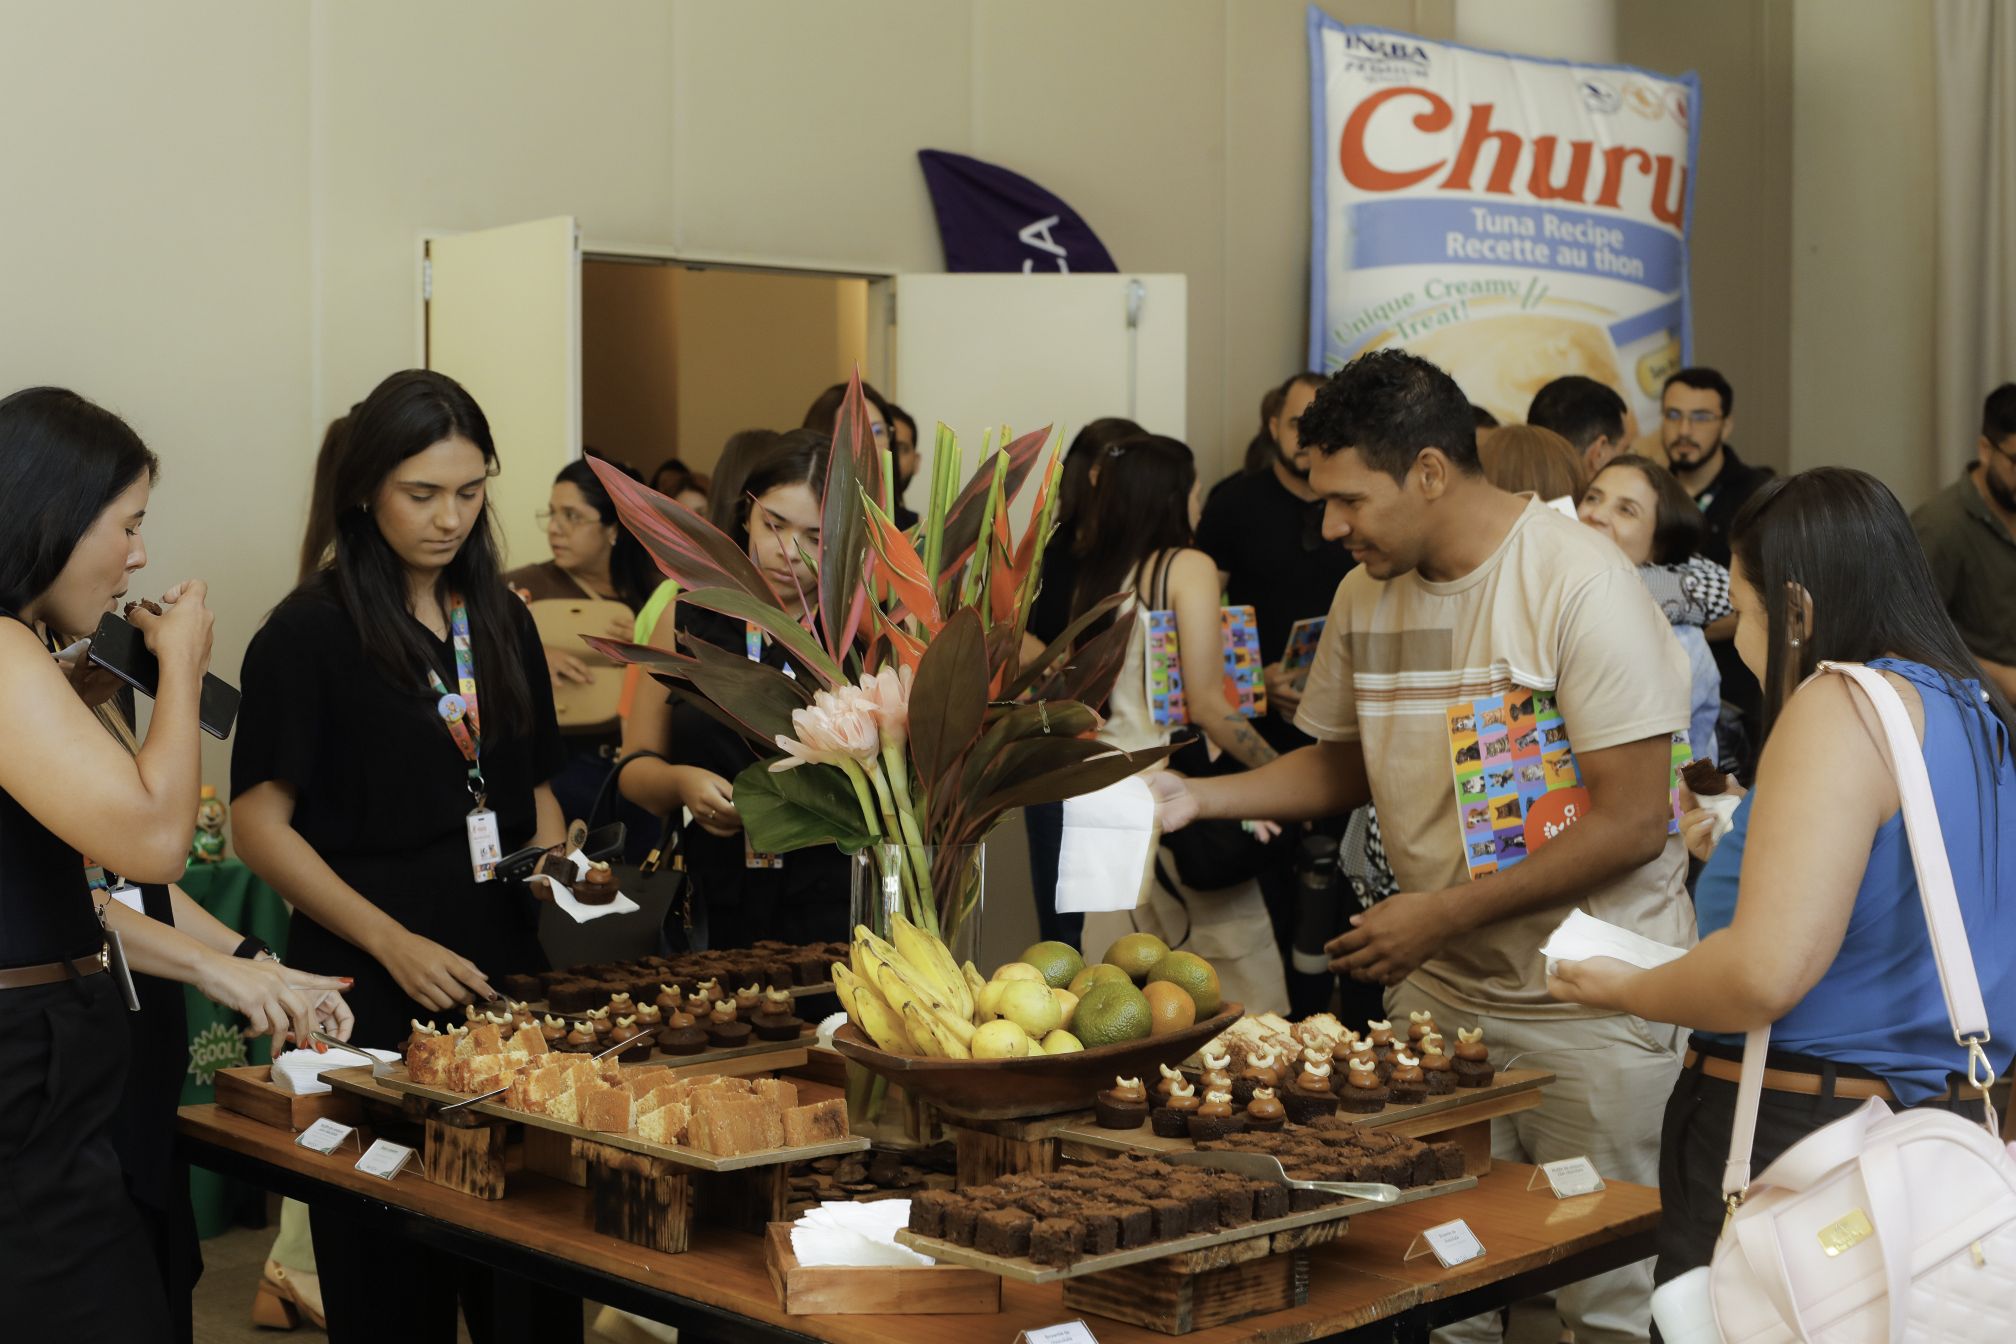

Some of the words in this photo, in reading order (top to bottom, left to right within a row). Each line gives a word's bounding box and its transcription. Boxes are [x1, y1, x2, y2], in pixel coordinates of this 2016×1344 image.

[1340, 85, 1687, 229] Churu
[1446, 232, 1550, 263] Recette
[1556, 244, 1588, 268] au
[1594, 248, 1644, 280] thon
[1471, 207, 1535, 236] Tuna
[1543, 213, 1624, 249] Recipe
[1334, 291, 1415, 344] Unique
[1424, 277, 1521, 302] Creamy
